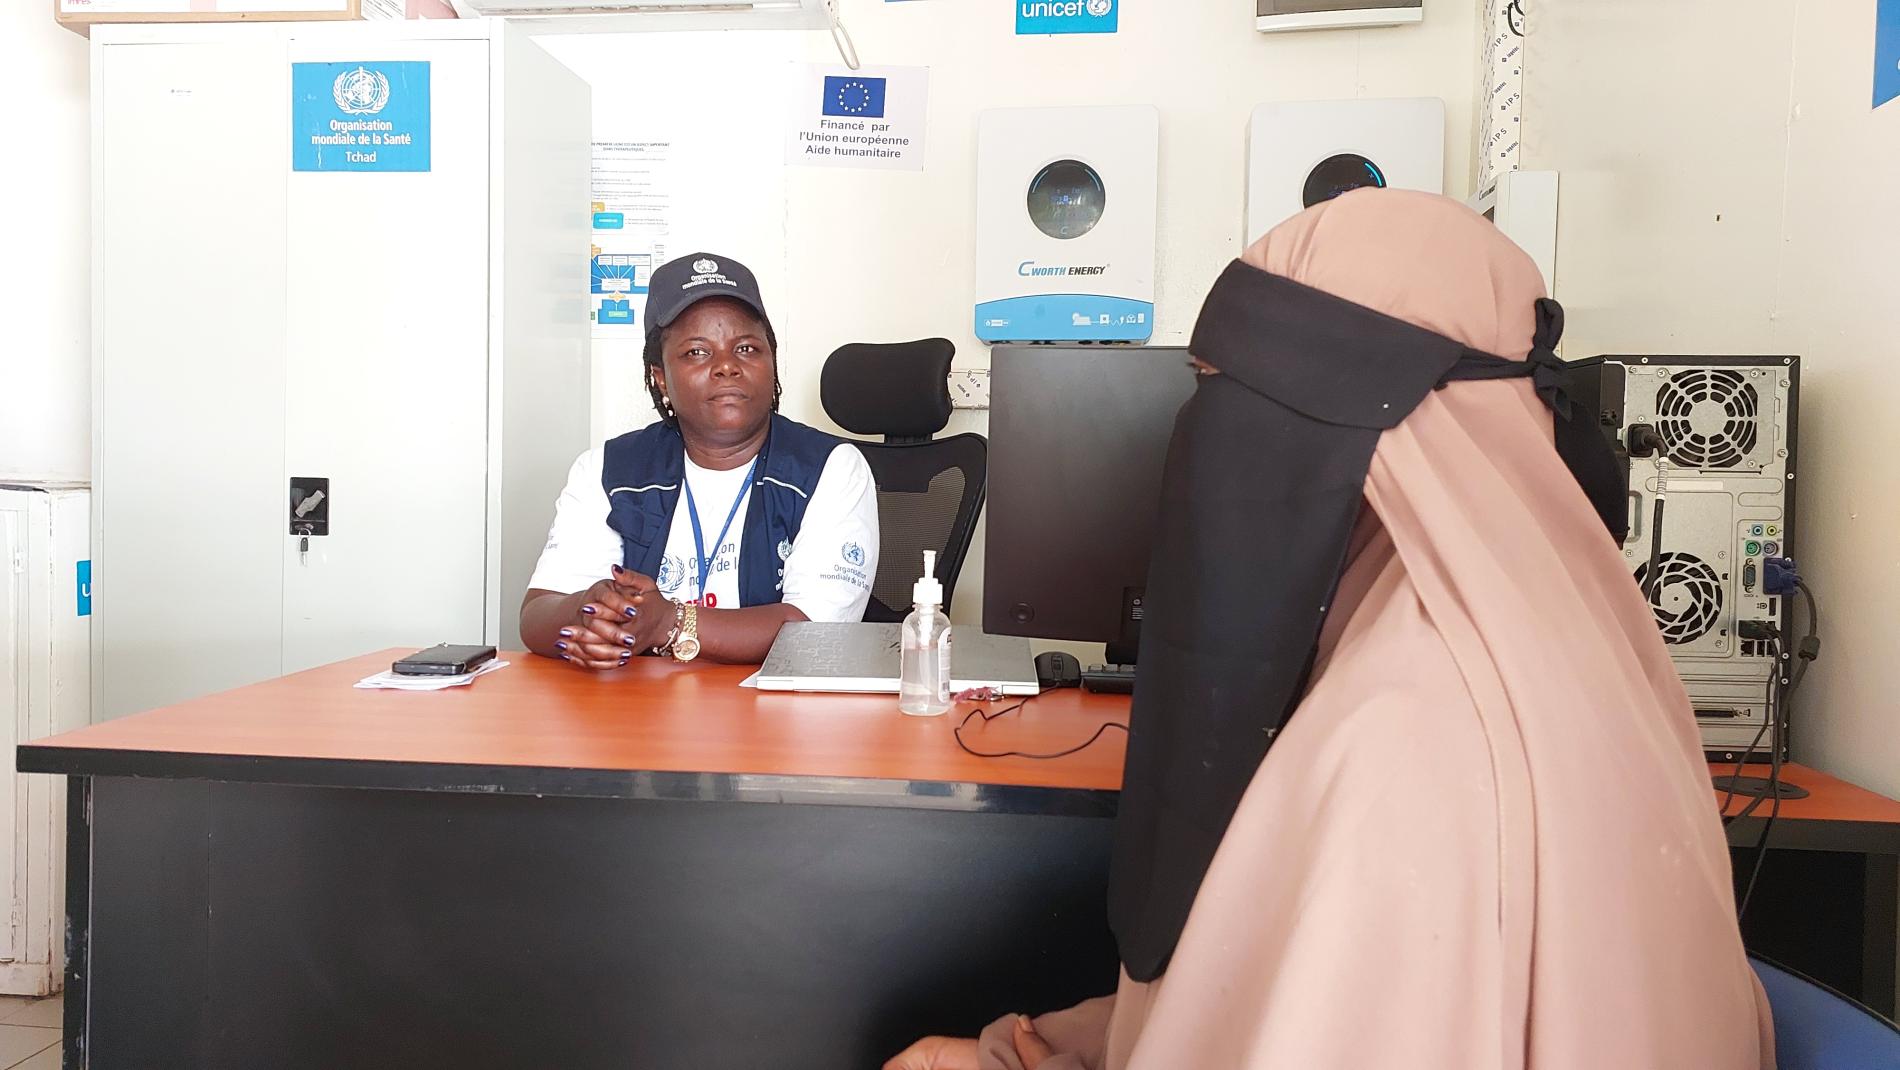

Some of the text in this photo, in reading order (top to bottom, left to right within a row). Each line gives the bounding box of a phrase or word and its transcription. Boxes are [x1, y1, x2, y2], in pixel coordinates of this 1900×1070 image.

[1022, 0, 1084, 17] unicef
[329, 119, 393, 133] Organisation
[820, 120, 890, 132] Financé par
[311, 133, 411, 145] mondiale de la Santé
[800, 132, 909, 146] l'Union européenne
[345, 151, 377, 163] Tchad
[805, 145, 901, 158] Aide humanitaire
[1068, 266, 1105, 276] ENERGY
[716, 557, 730, 572] de
